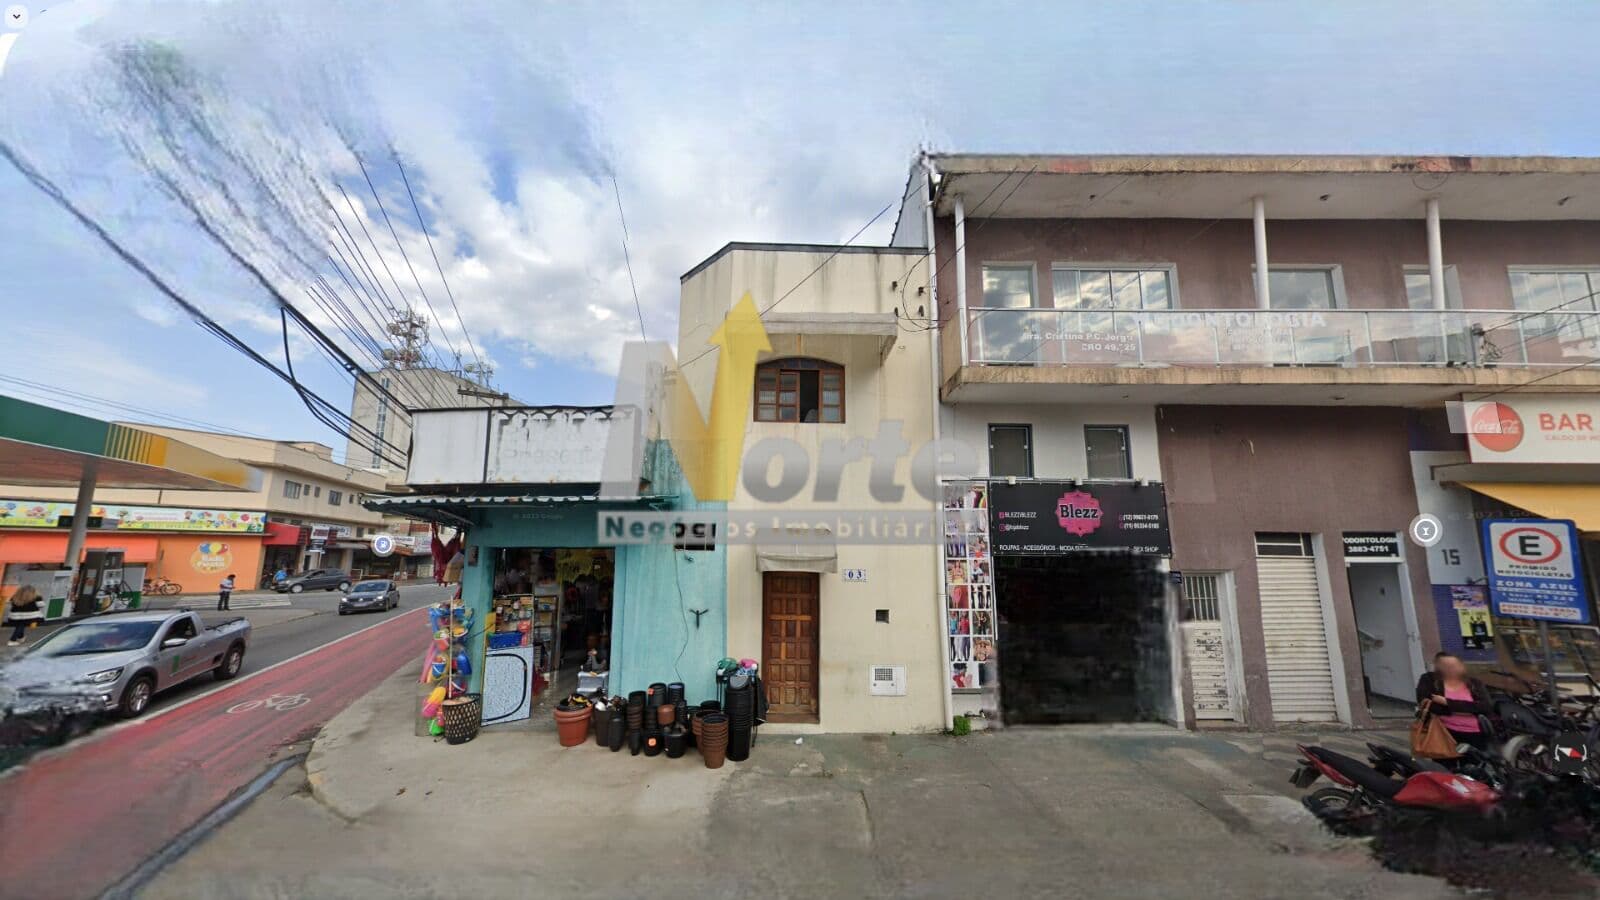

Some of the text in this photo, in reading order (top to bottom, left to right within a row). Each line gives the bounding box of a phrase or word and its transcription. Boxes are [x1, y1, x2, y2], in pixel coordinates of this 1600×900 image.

[1539, 412, 1593, 431] BAR
[1060, 504, 1099, 519] Blezz
[1518, 535, 1542, 556] E
[1441, 549, 1461, 566] 15
[1496, 580, 1577, 591] ZONA AZUL
